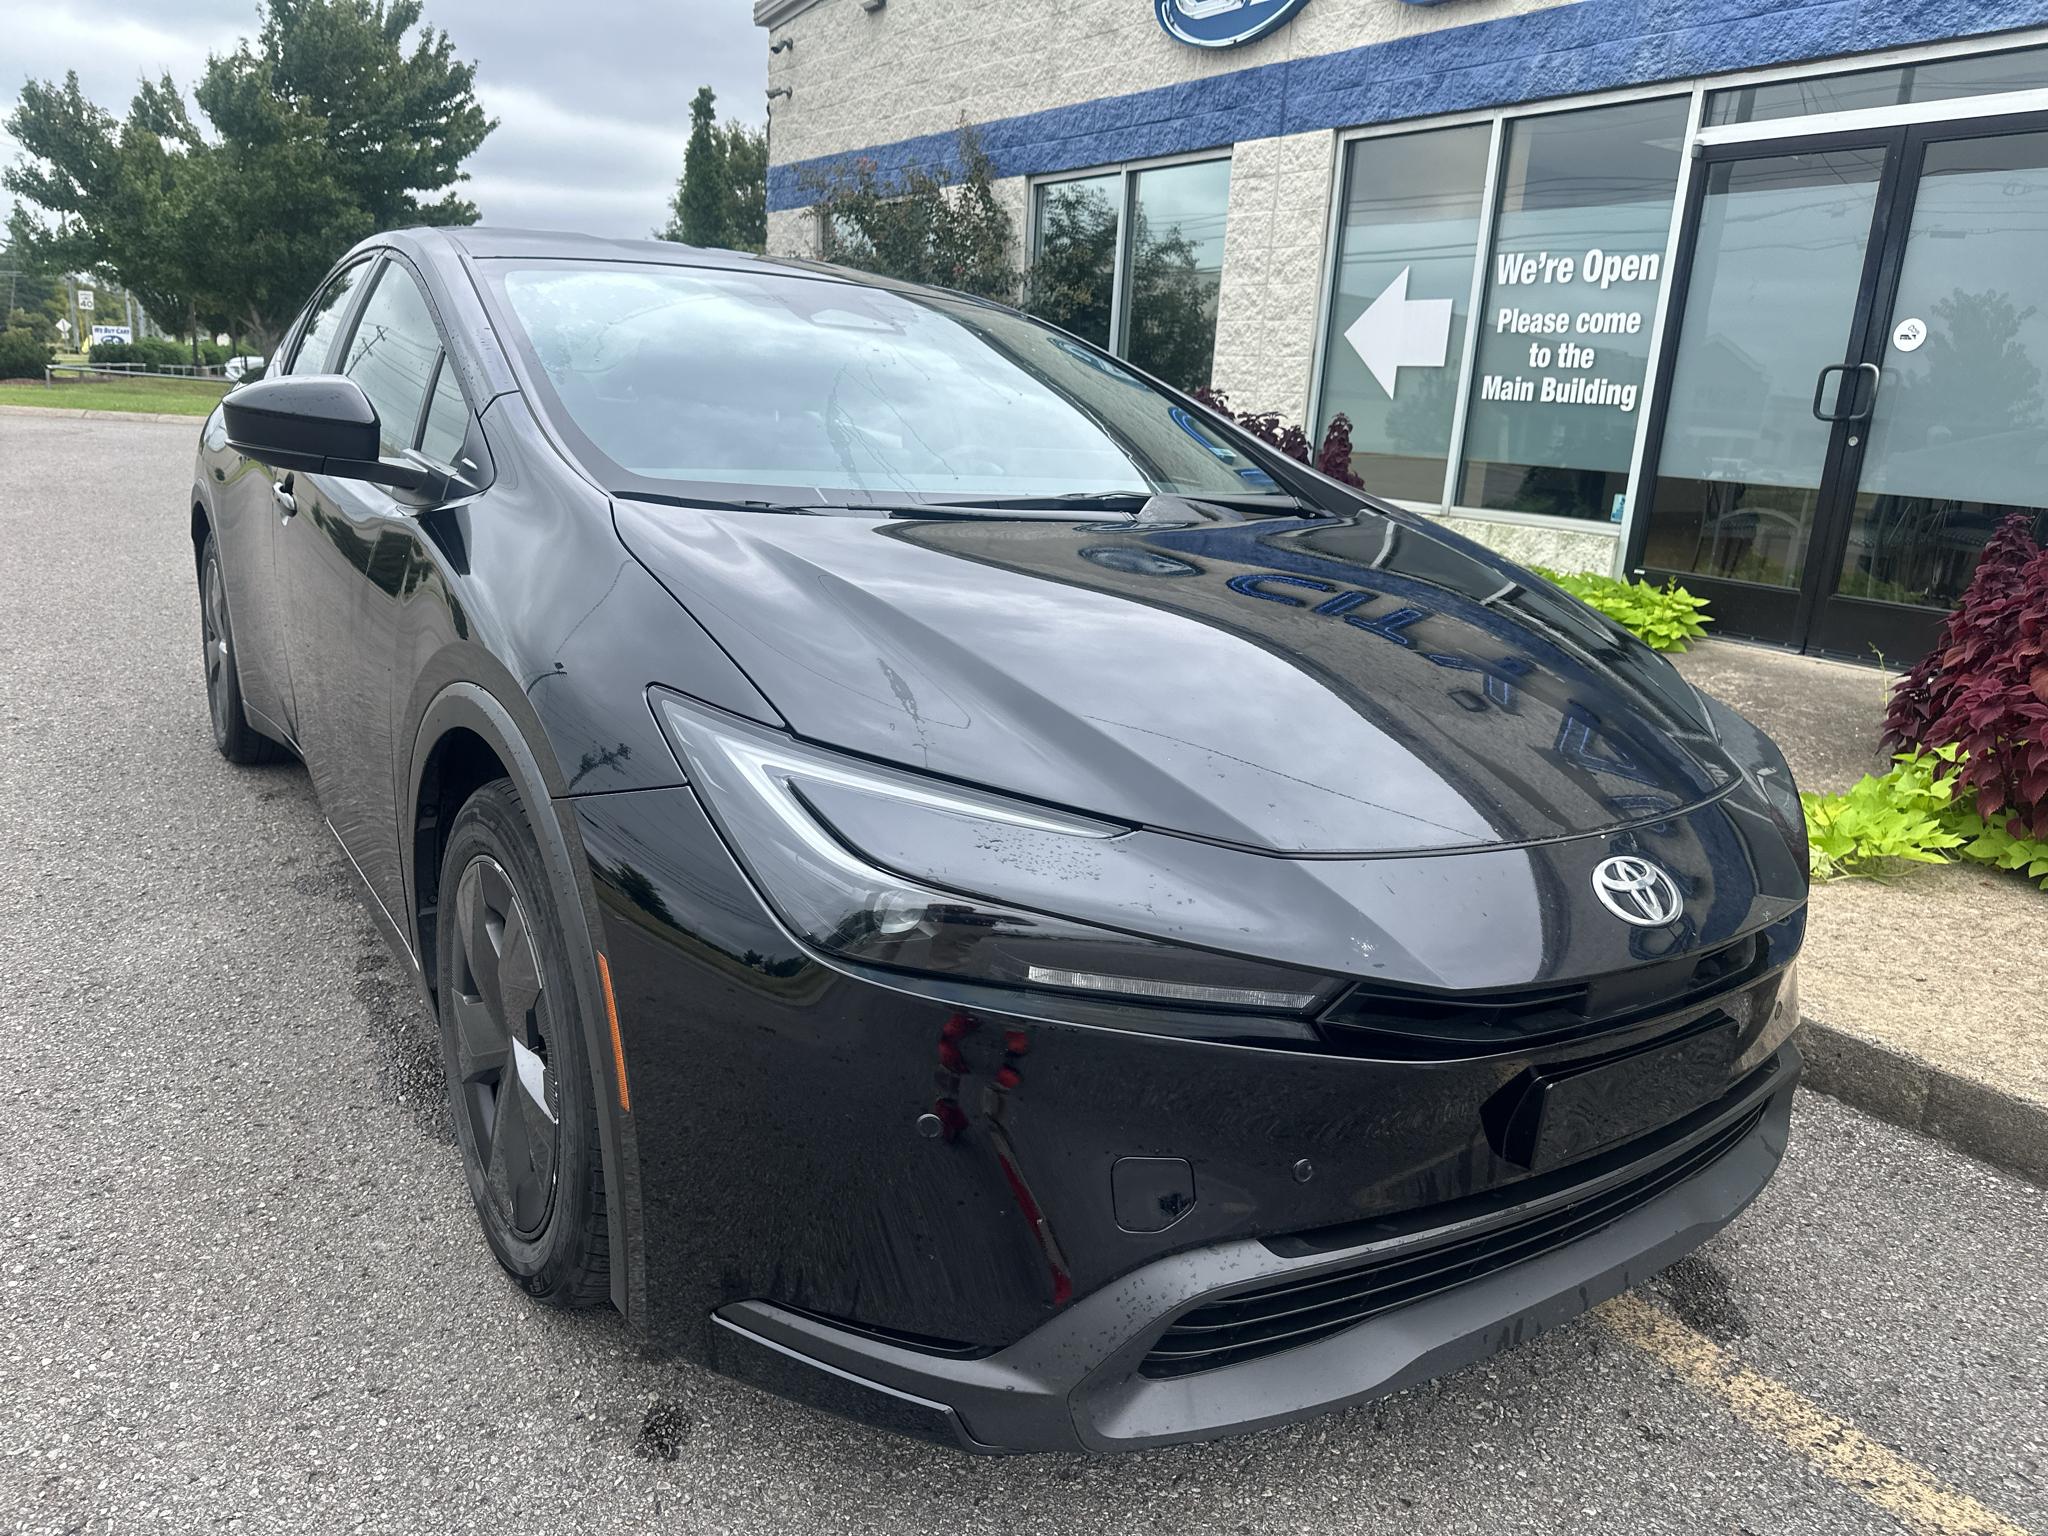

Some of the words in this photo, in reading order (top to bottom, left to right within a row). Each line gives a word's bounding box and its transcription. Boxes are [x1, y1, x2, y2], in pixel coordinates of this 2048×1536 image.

[1498, 252, 1574, 285] We're
[1582, 249, 1660, 290] Open
[1497, 308, 1570, 334] Please
[1576, 312, 1641, 334] come
[1529, 342, 1551, 368] to
[1558, 343, 1595, 369] the
[1481, 375, 1535, 401] Main
[1540, 377, 1637, 412] Building
